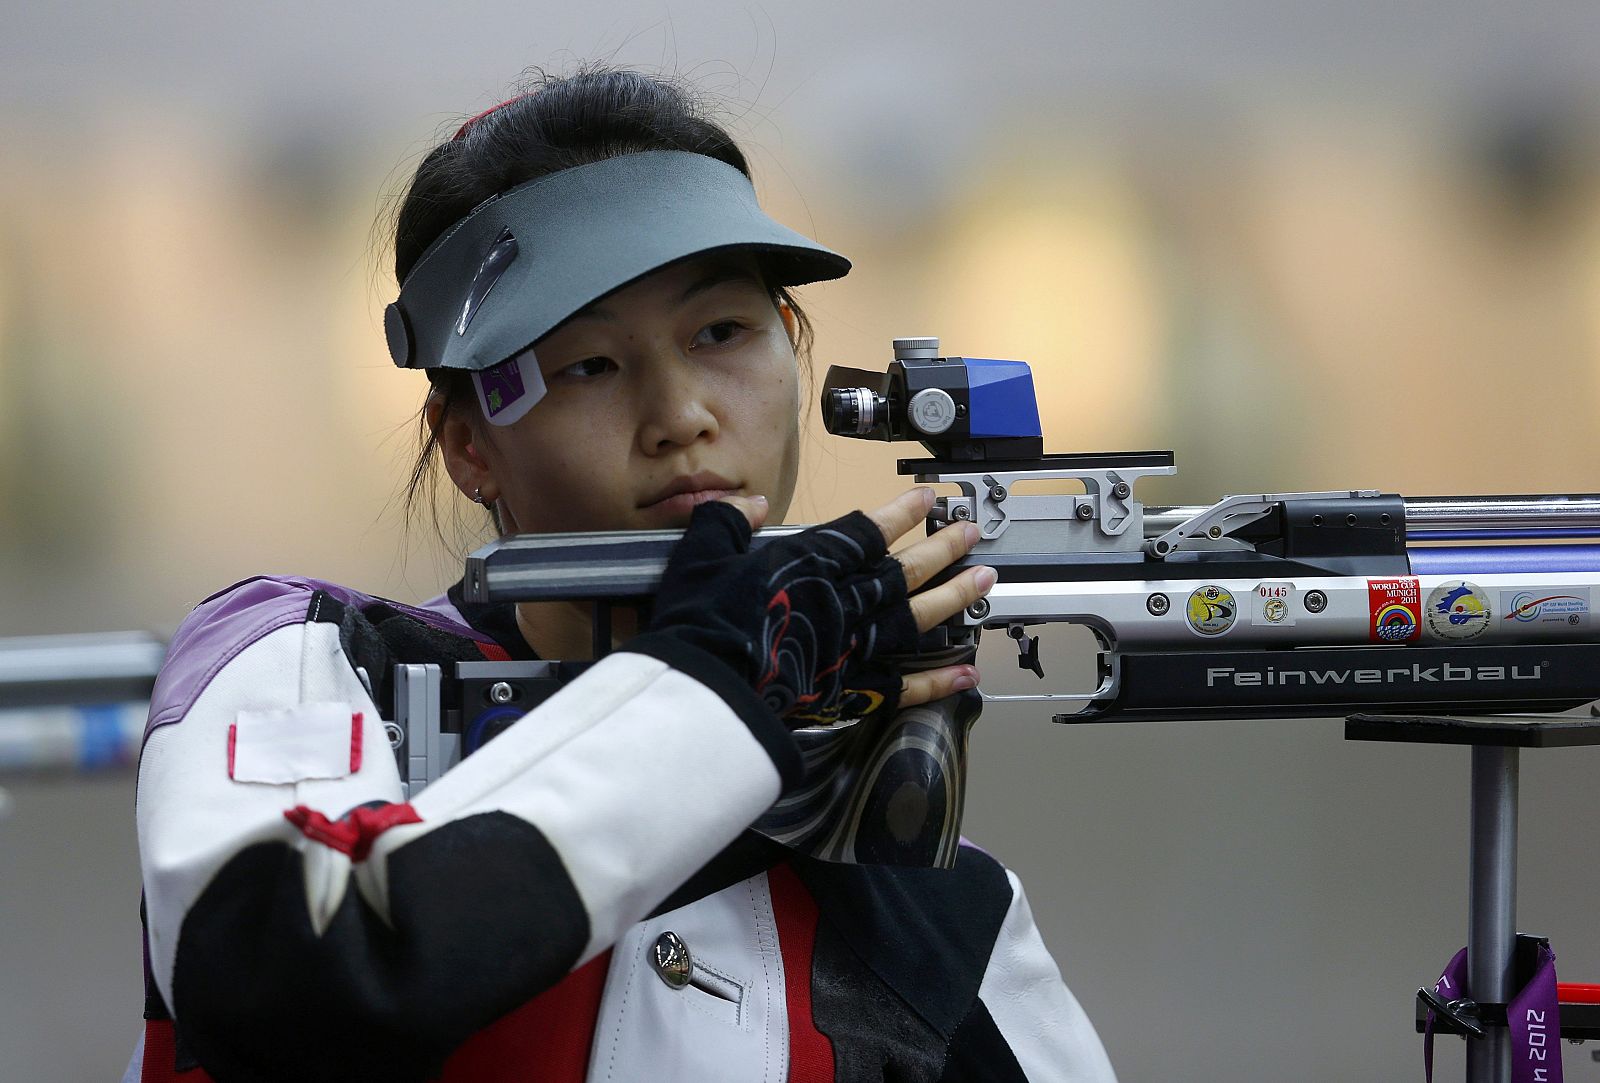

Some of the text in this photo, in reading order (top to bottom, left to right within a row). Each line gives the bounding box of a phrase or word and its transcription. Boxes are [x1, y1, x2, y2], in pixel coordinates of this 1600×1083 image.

[1260, 586, 1288, 598] 0145
[1371, 583, 1398, 591] WORLD
[1386, 589, 1417, 598] MUNICH
[1401, 596, 1417, 604] 2011
[1207, 662, 1541, 687] Feinwerkbau
[1526, 1009, 1547, 1061] 2012
